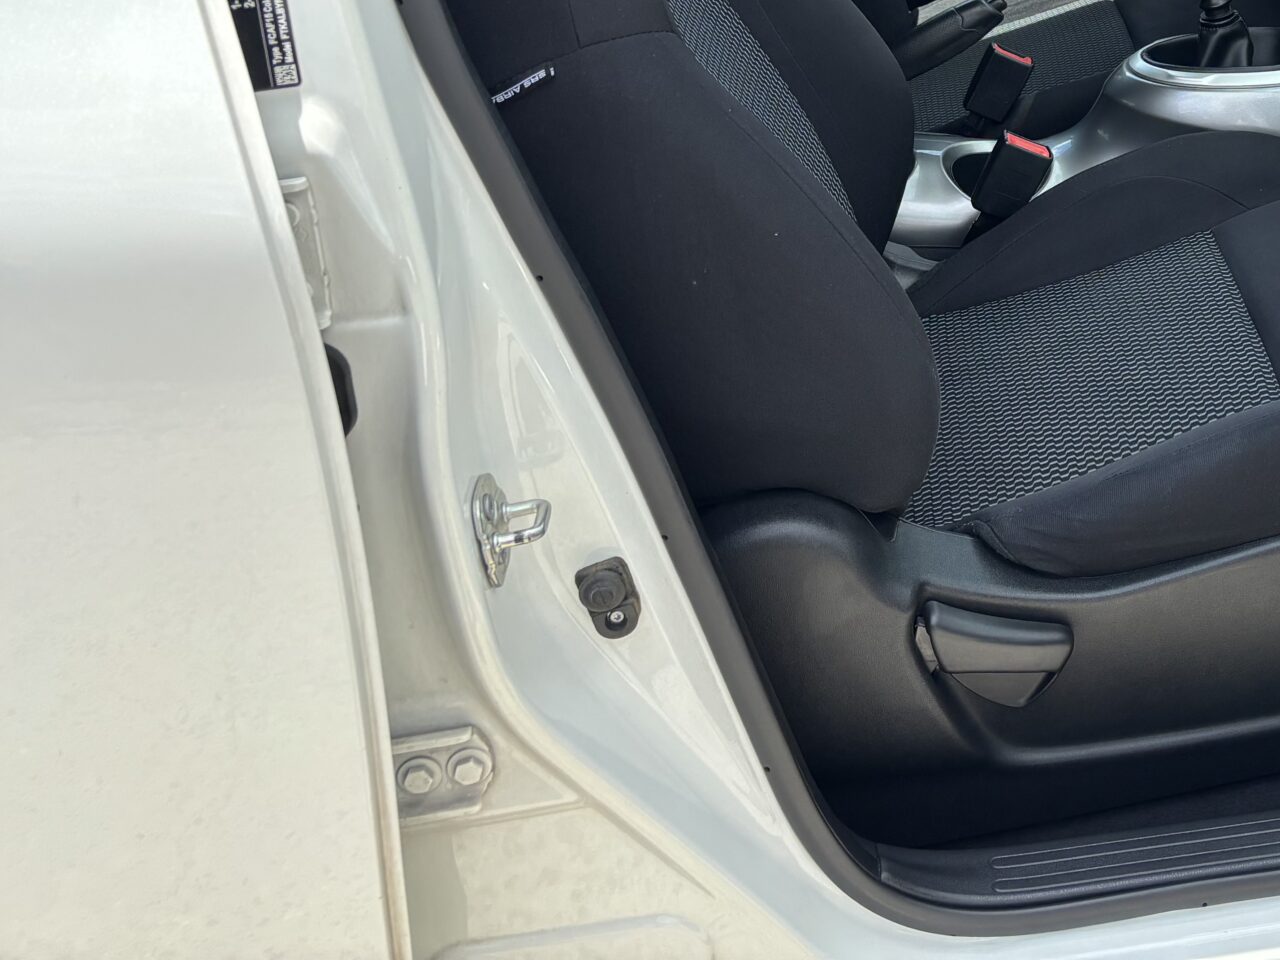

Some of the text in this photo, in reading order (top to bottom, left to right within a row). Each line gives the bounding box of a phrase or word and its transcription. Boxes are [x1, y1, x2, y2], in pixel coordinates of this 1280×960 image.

[272, 46, 284, 65] Type
[282, 41, 295, 63] Model
[523, 69, 546, 88] SRS
